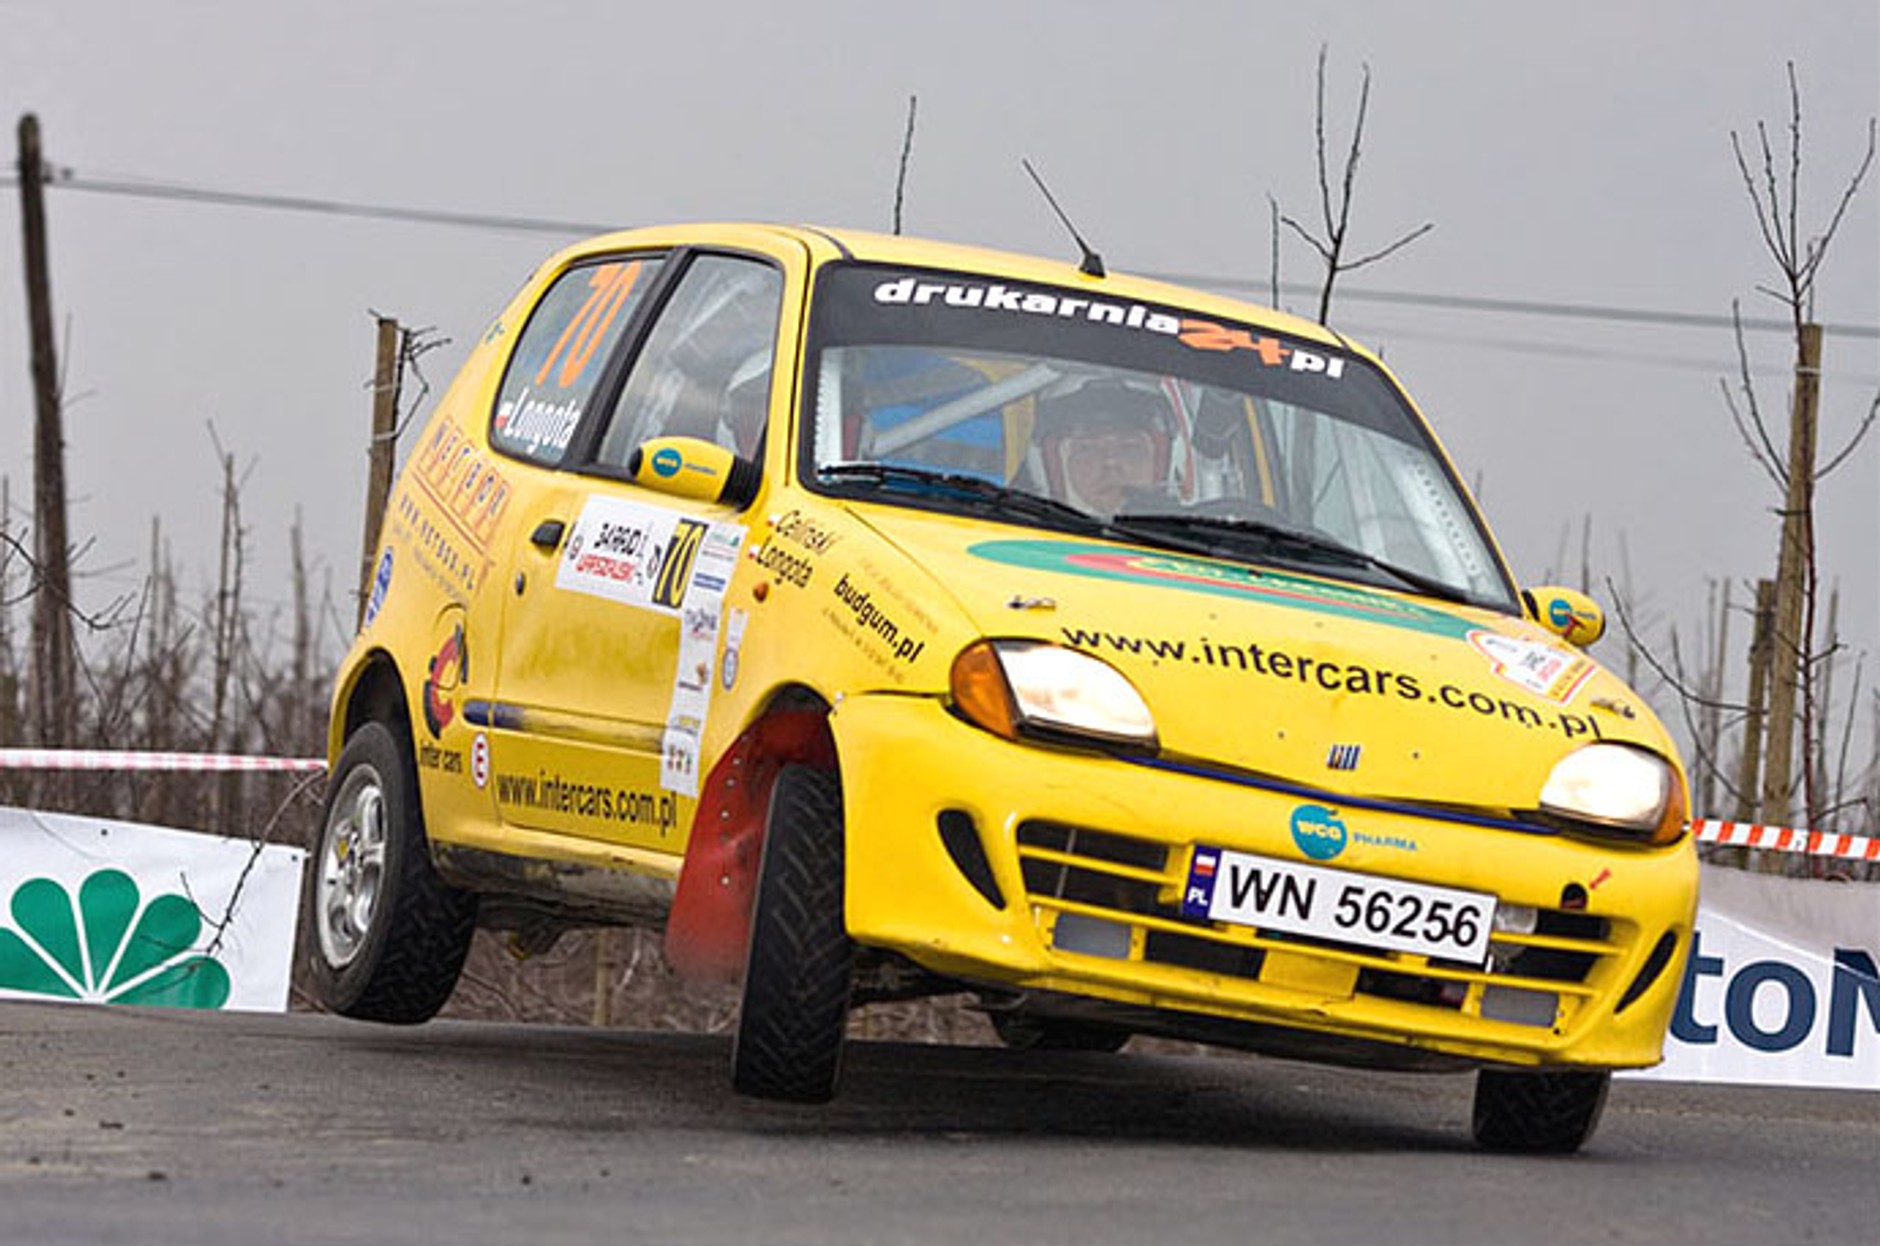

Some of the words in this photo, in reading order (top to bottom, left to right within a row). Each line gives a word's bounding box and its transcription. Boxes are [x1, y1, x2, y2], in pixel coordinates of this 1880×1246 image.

[535, 260, 642, 388] 70
[653, 518, 707, 607] 70
[833, 572, 925, 663] budgum.pl
[1061, 624, 1601, 740] www.intercars.com.pl
[496, 769, 678, 837] www.intercars.com.pl
[1187, 886, 1208, 905] PL
[1229, 864, 1317, 921] WN
[1334, 885, 1481, 948] 56256
